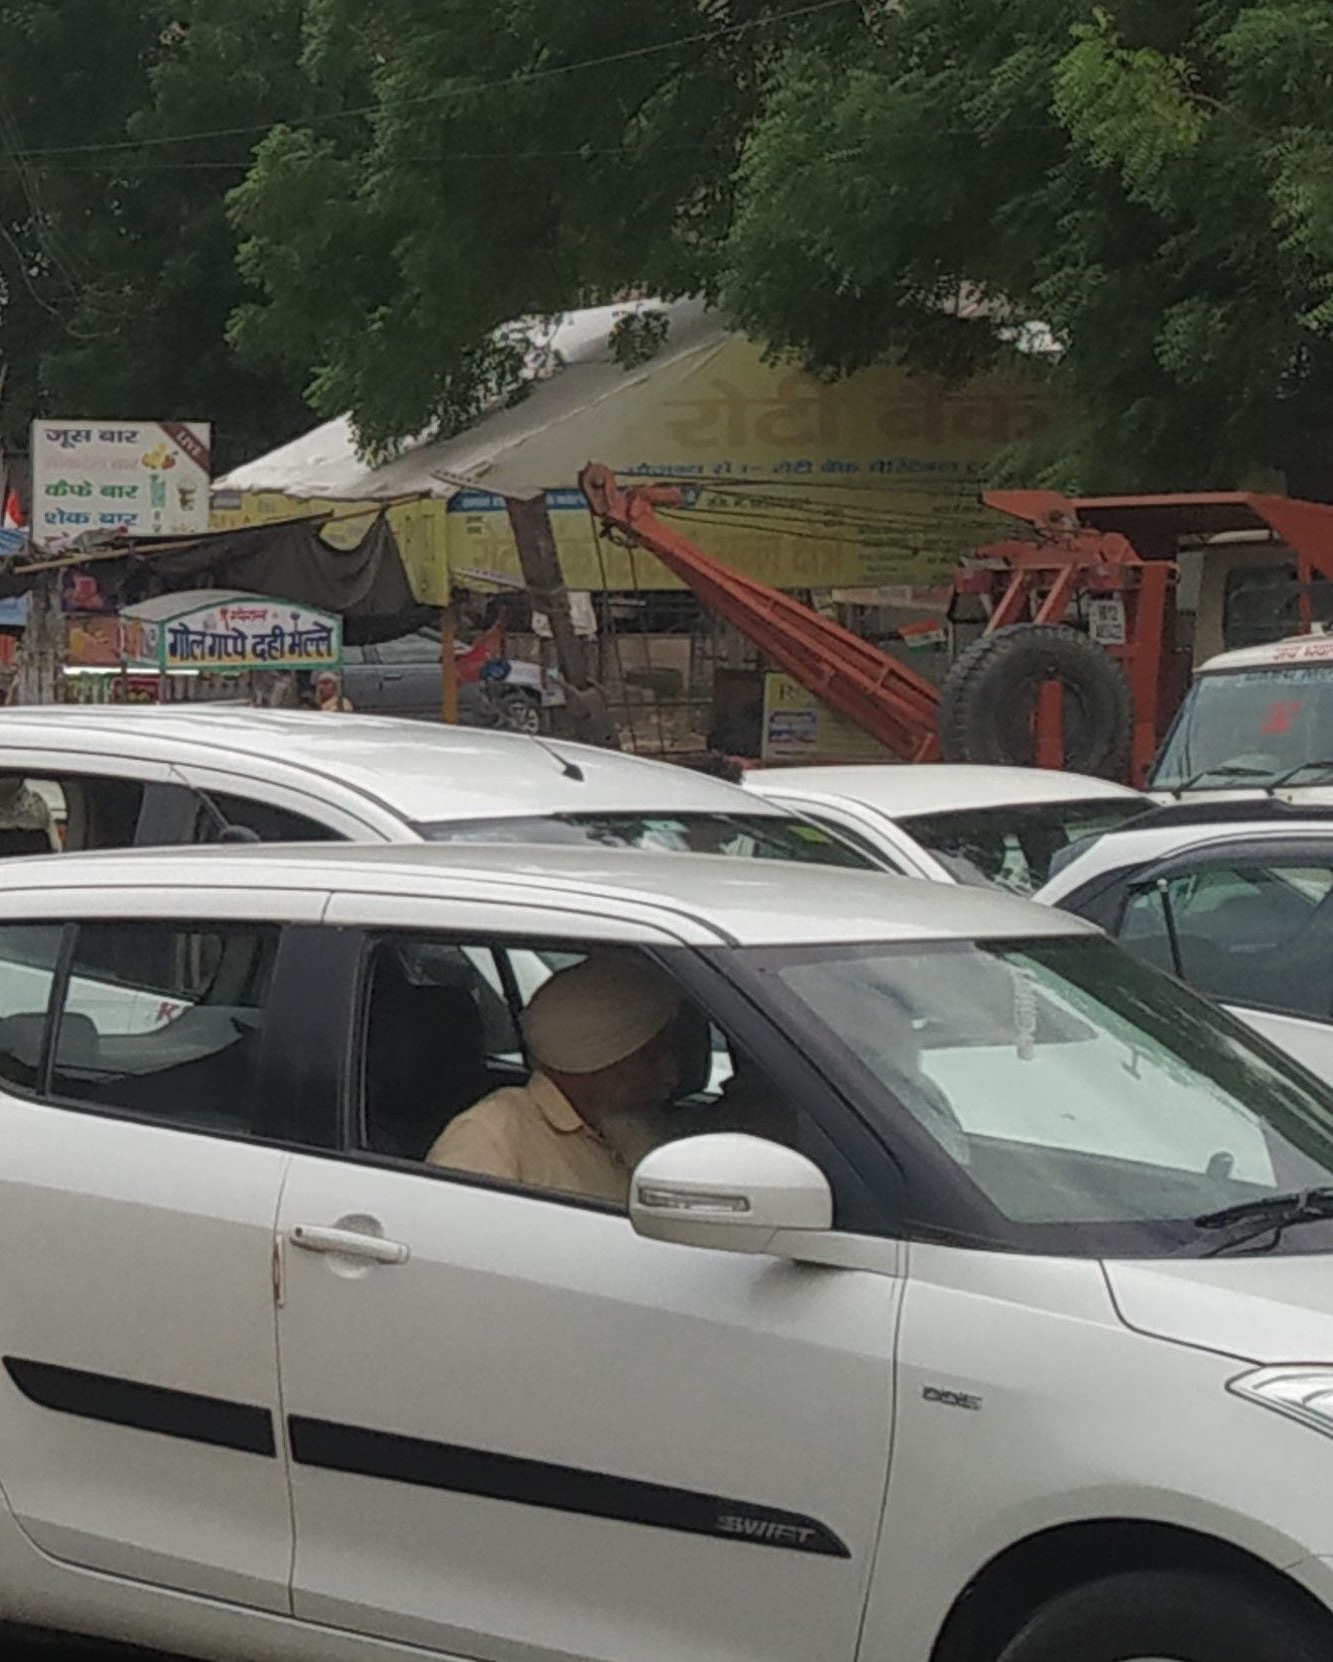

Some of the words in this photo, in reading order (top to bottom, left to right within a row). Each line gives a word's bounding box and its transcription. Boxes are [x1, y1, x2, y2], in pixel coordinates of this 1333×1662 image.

[45, 429, 91, 449] जूस
[100, 485, 140, 499] बार
[168, 622, 207, 660] गोल
[251, 625, 284, 661] दही
[716, 1516, 816, 1542] SWIFT
